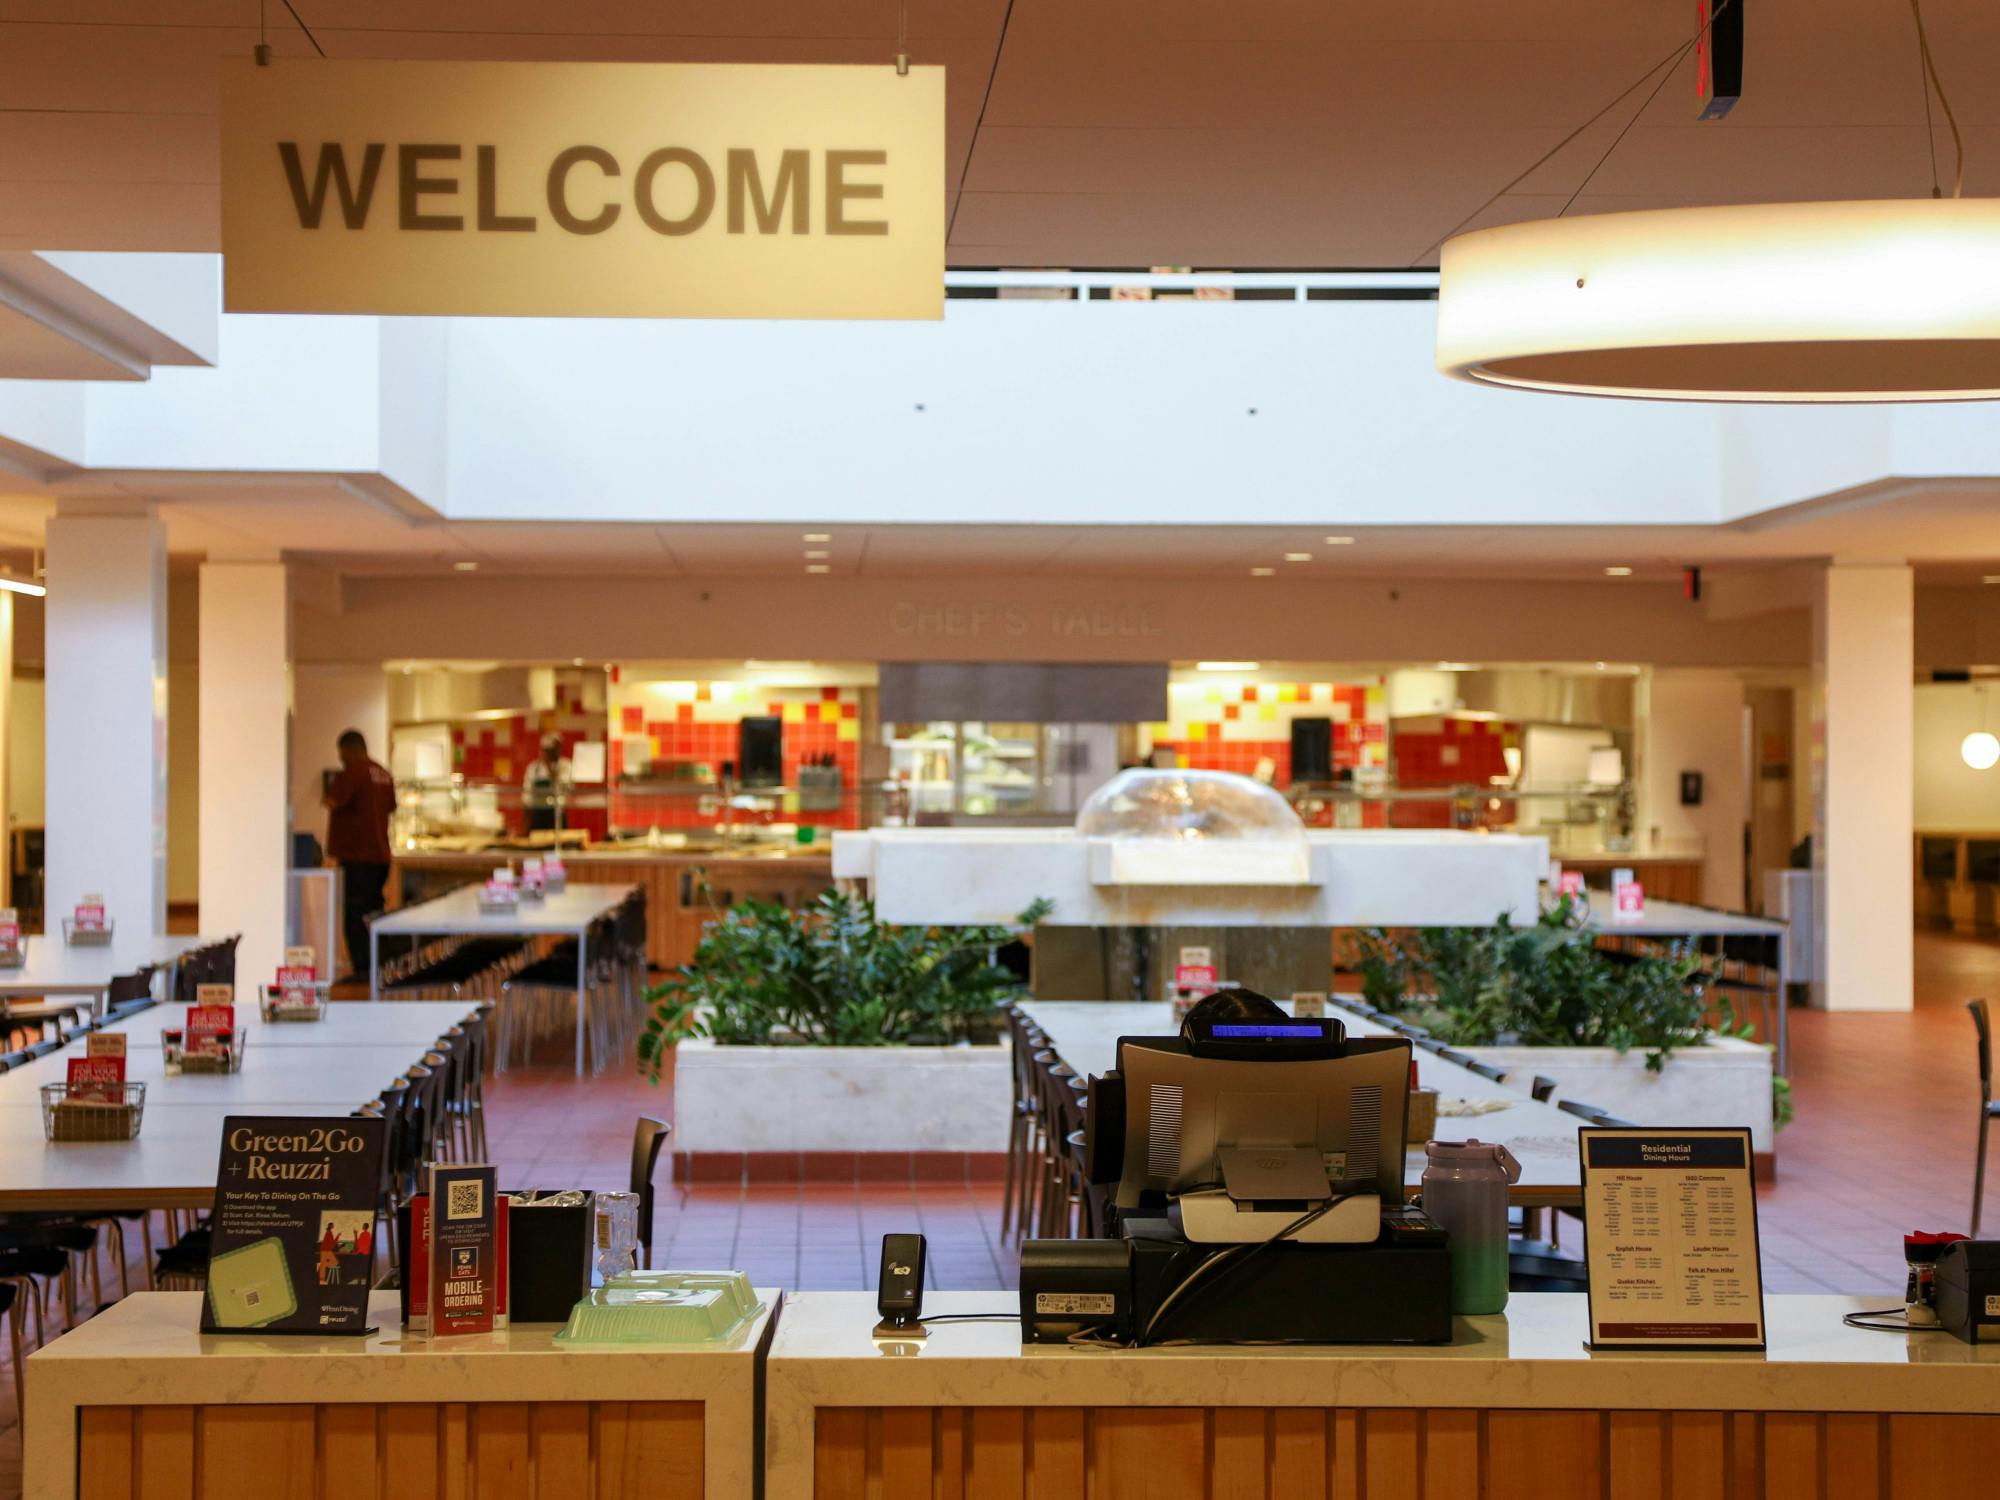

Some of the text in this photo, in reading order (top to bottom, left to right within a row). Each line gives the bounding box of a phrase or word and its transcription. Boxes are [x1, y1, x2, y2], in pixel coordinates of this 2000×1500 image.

[277, 141, 889, 236] WELCOME
[230, 1128, 364, 1152] Green2Go
[1641, 1144, 1691, 1153] Residential
[1643, 1154, 1667, 1162] Dining
[228, 1156, 330, 1179] + Reuzzi
[225, 1191, 341, 1203] Your Key To Dining On The Go
[444, 1280, 482, 1296] MOBILE
[444, 1295, 483, 1308] ORDERING
